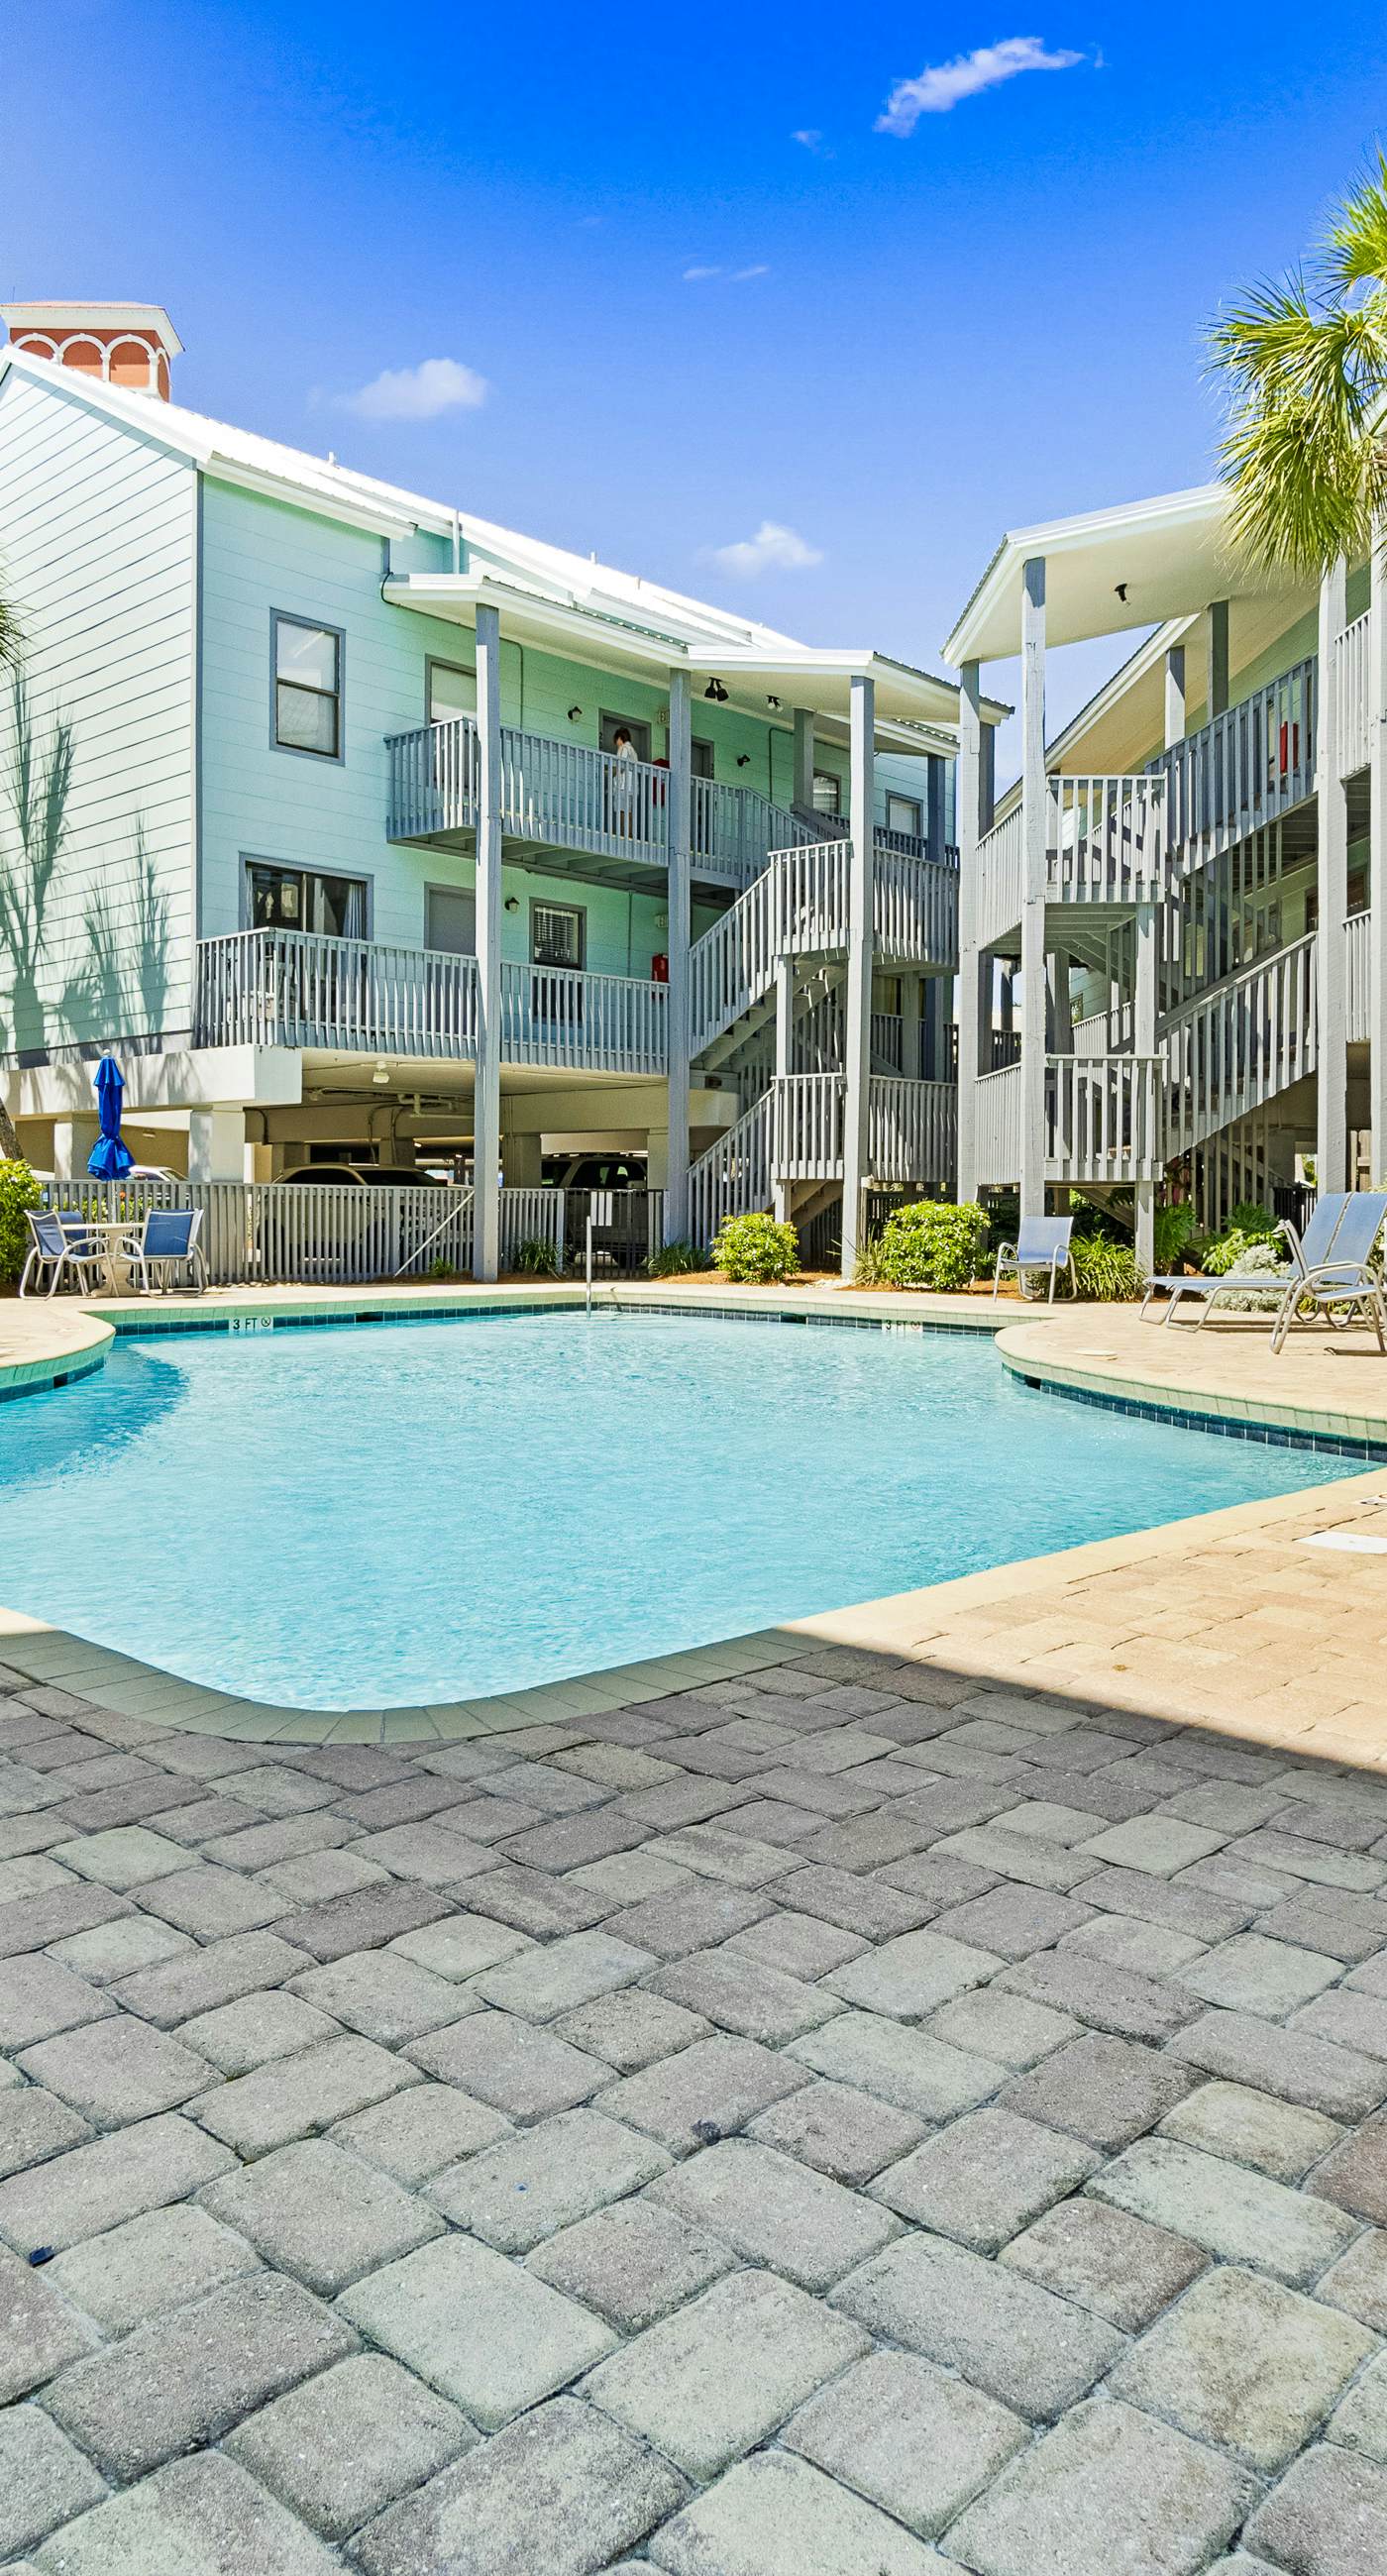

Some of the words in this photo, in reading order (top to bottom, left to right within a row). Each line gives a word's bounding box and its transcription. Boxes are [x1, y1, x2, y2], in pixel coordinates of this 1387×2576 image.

[233, 1319, 240, 1330] 3
[245, 1318, 258, 1330] FT
[886, 1320, 892, 1330] 3
